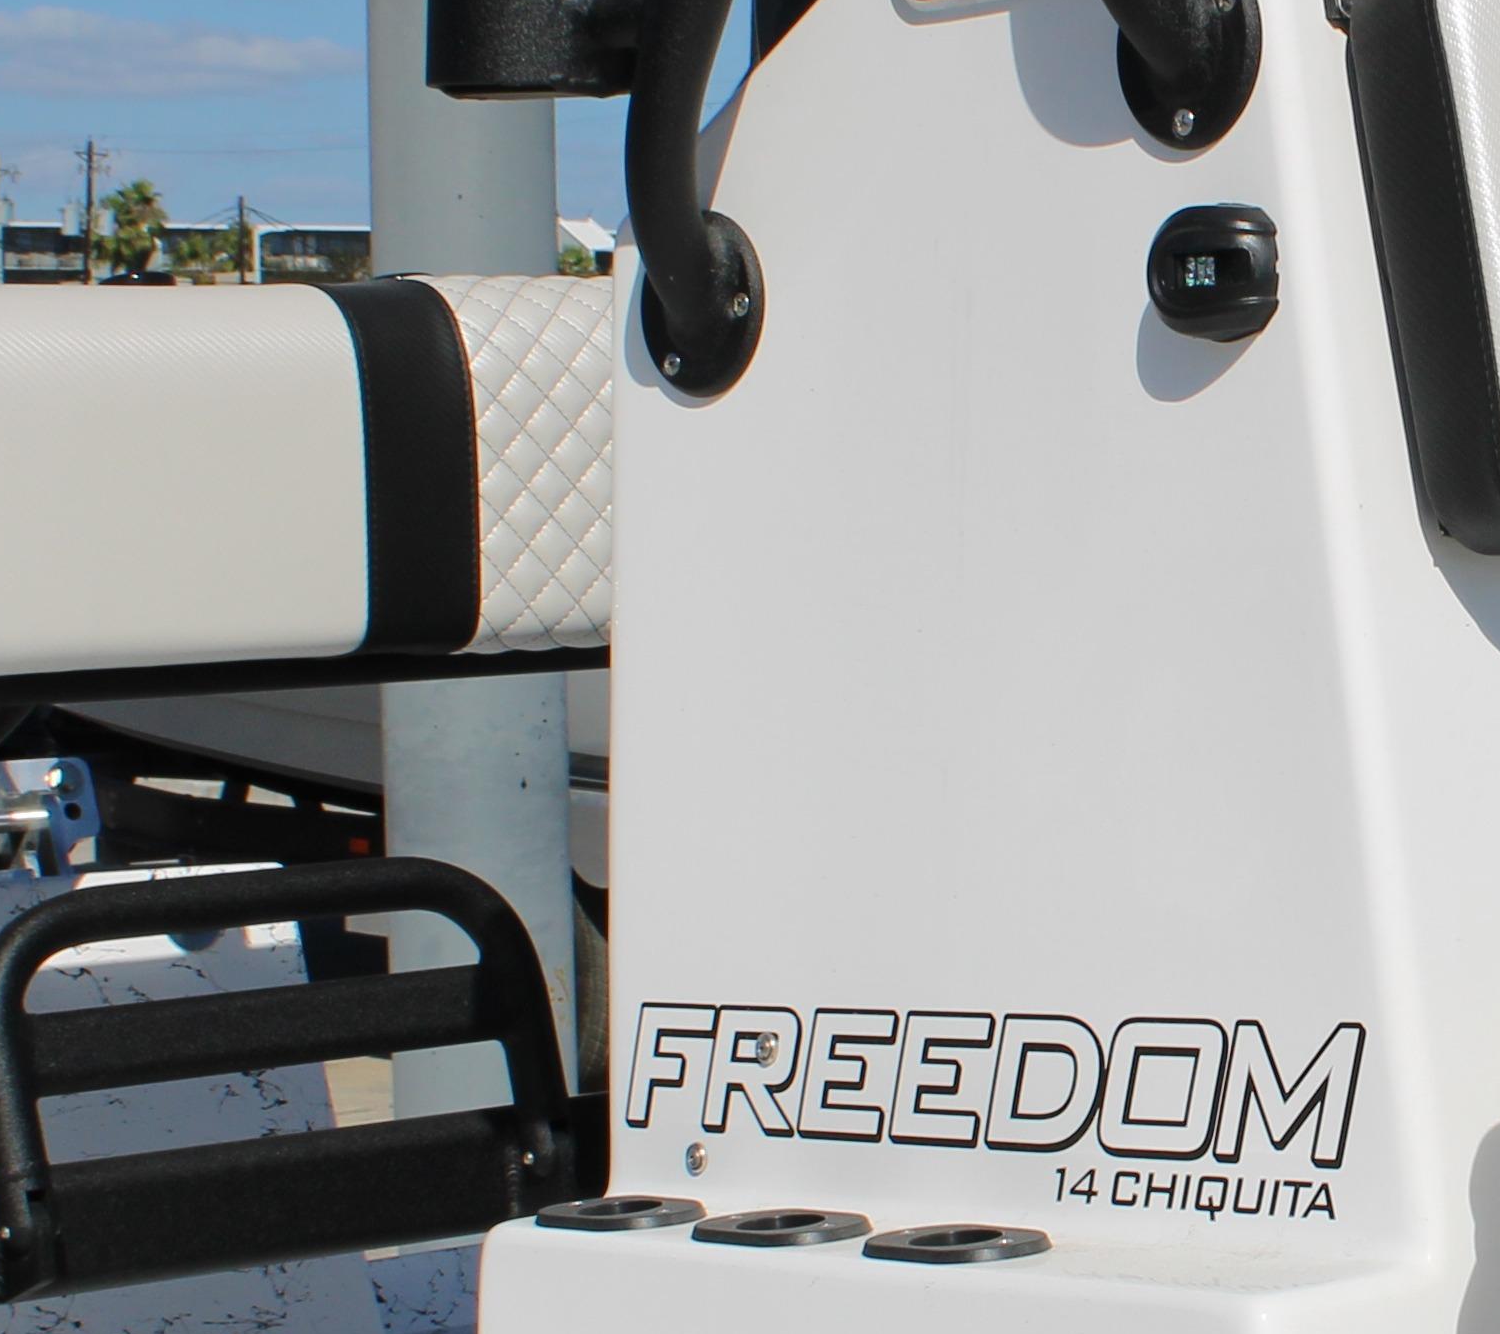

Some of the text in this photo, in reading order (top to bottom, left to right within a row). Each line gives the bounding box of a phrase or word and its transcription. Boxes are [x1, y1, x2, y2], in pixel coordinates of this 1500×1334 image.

[625, 1003, 1366, 1168] FREEDOM
[1054, 1167, 1337, 1223] 14 CHIQUITA
